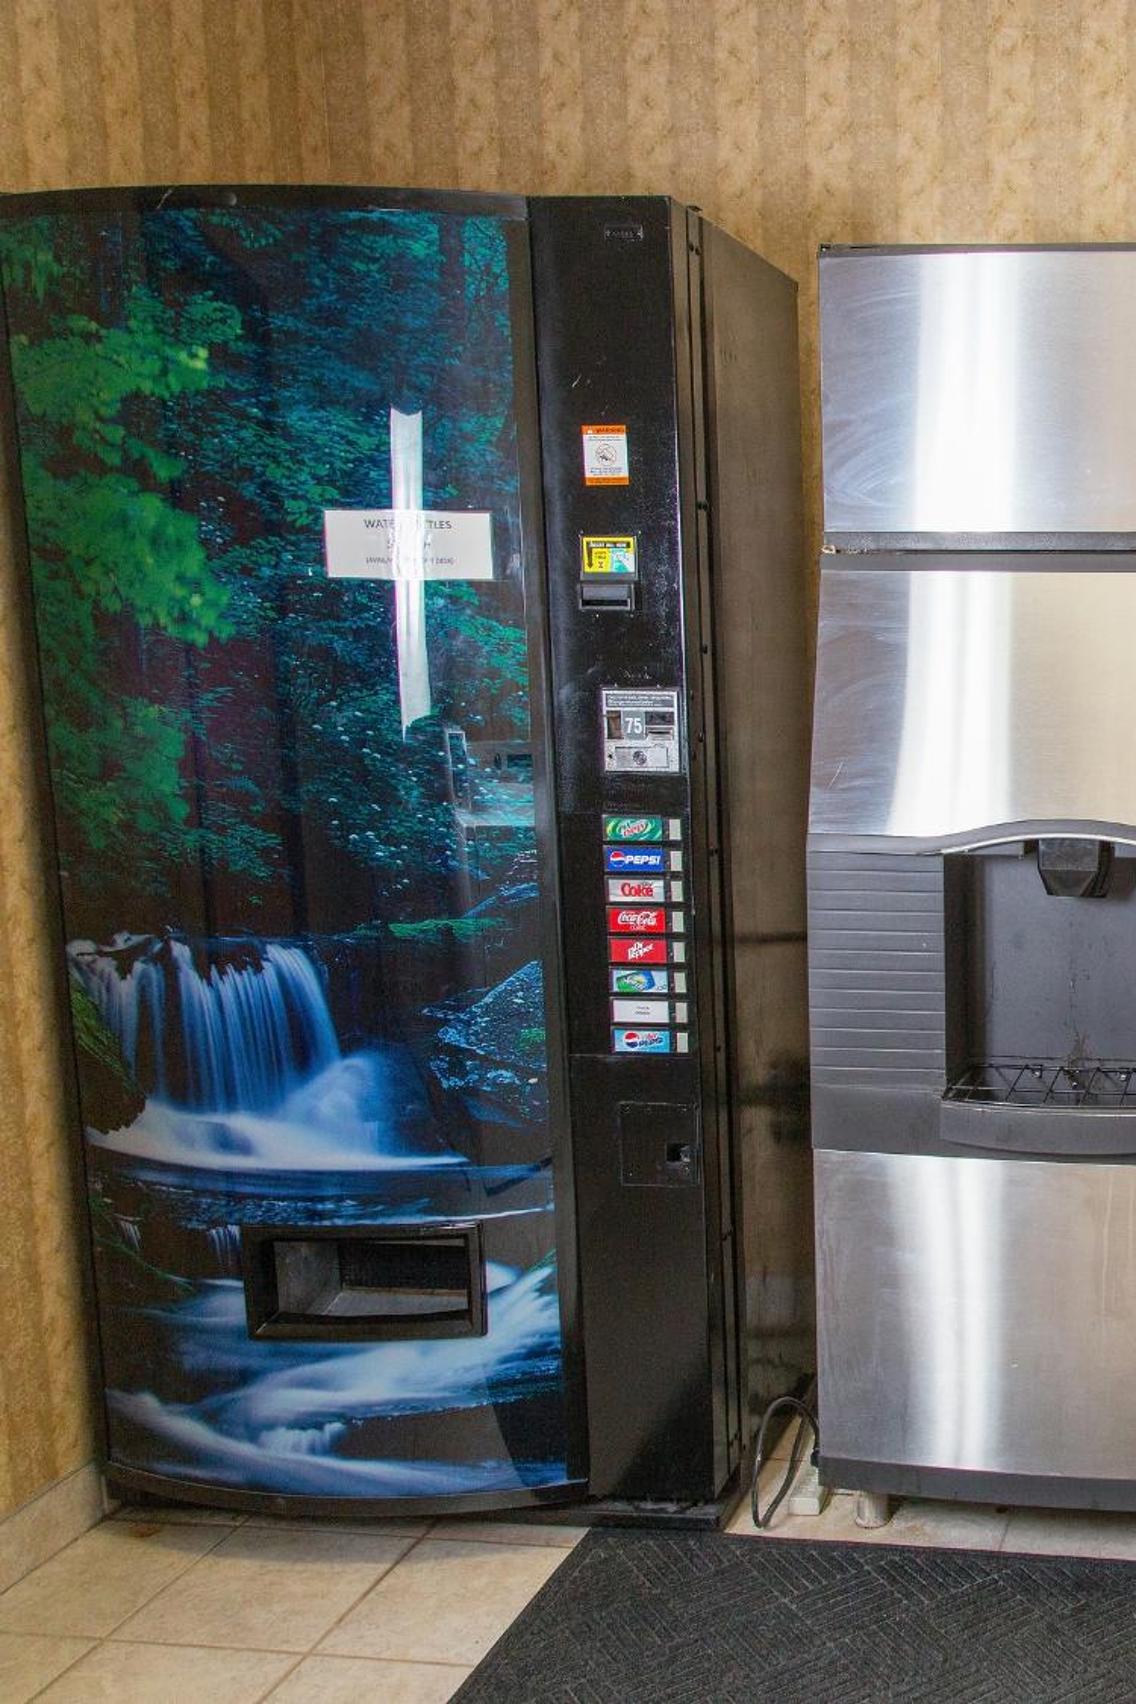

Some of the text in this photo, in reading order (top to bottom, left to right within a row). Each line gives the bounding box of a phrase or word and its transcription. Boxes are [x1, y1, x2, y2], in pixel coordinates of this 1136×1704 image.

[363, 519, 399, 529] WATE
[624, 717, 643, 734] 75
[625, 854, 661, 865] PEPSI
[621, 882, 654, 897] Coke
